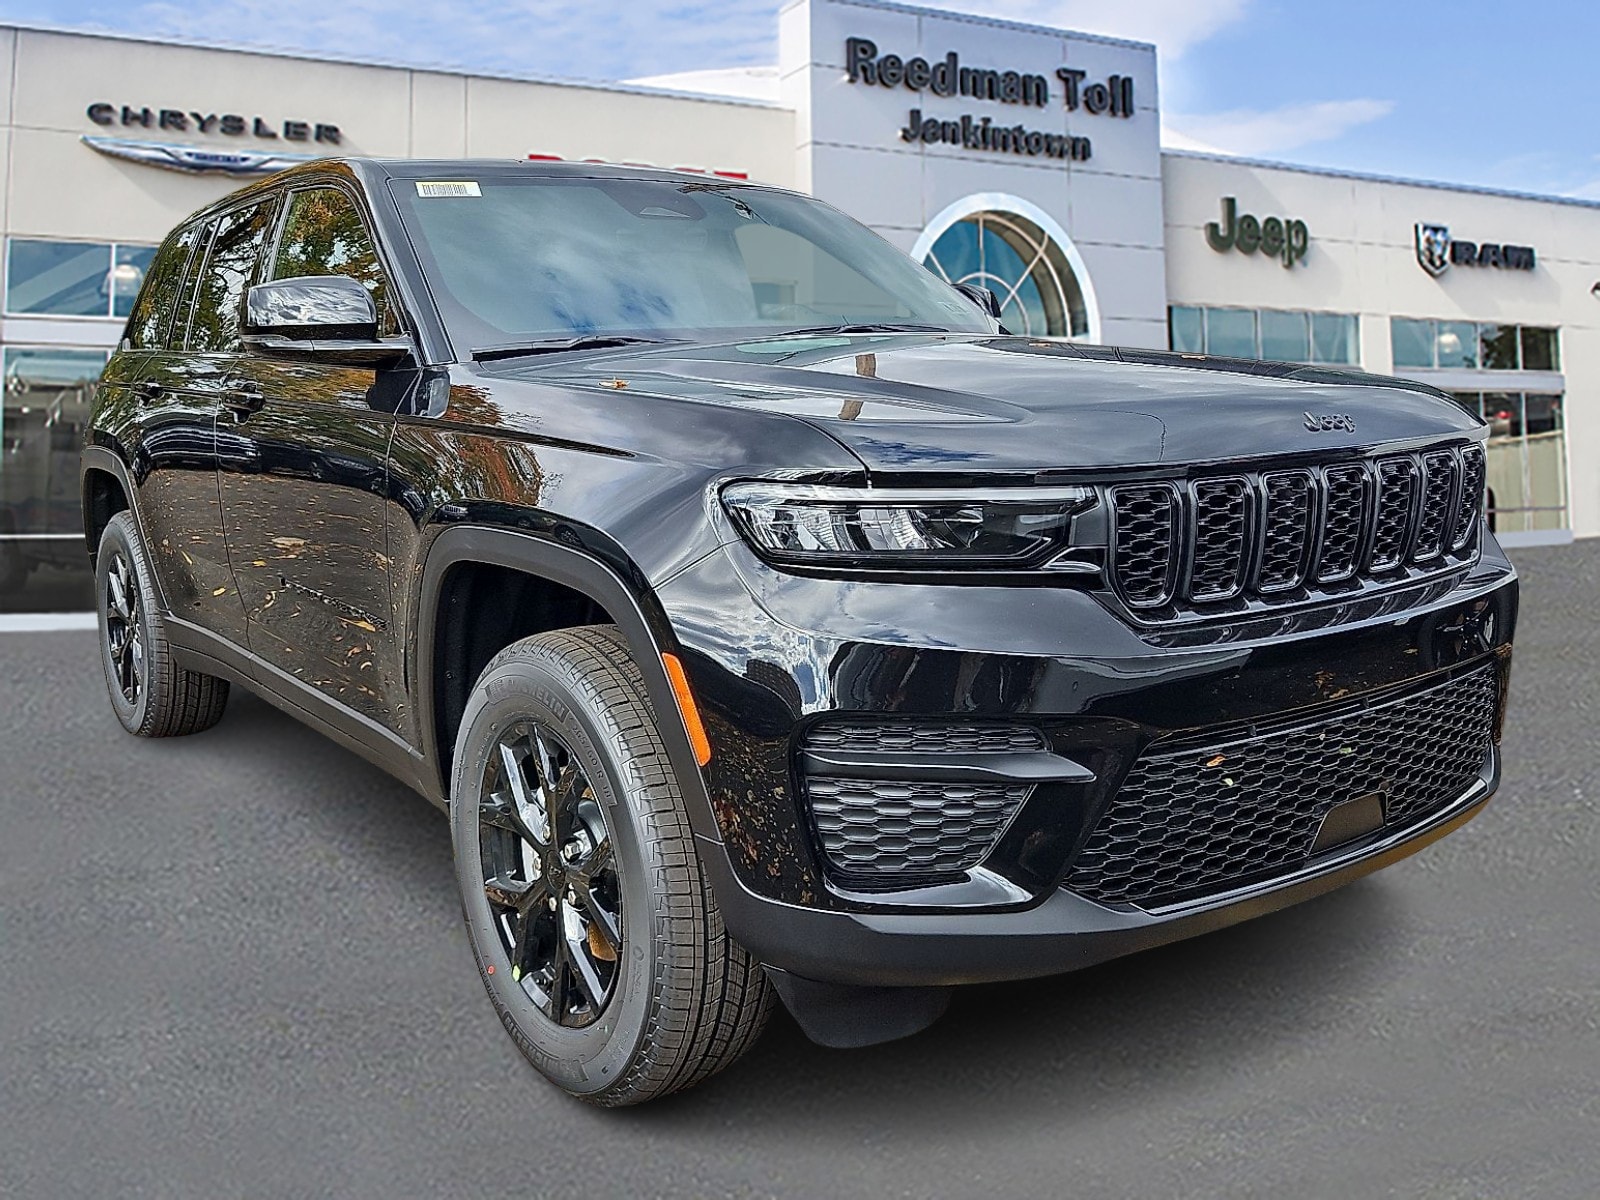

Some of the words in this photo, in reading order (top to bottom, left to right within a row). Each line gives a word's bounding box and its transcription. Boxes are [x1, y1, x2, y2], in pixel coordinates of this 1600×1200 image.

[845, 37, 1049, 107] Reedman
[1056, 67, 1135, 118] Toll
[86, 102, 342, 145] CHRYSLER
[901, 109, 1092, 161] Jenkintown
[1205, 196, 1308, 270] Jeep
[1450, 239, 1536, 271] RAM
[1303, 410, 1355, 434] Jeep
